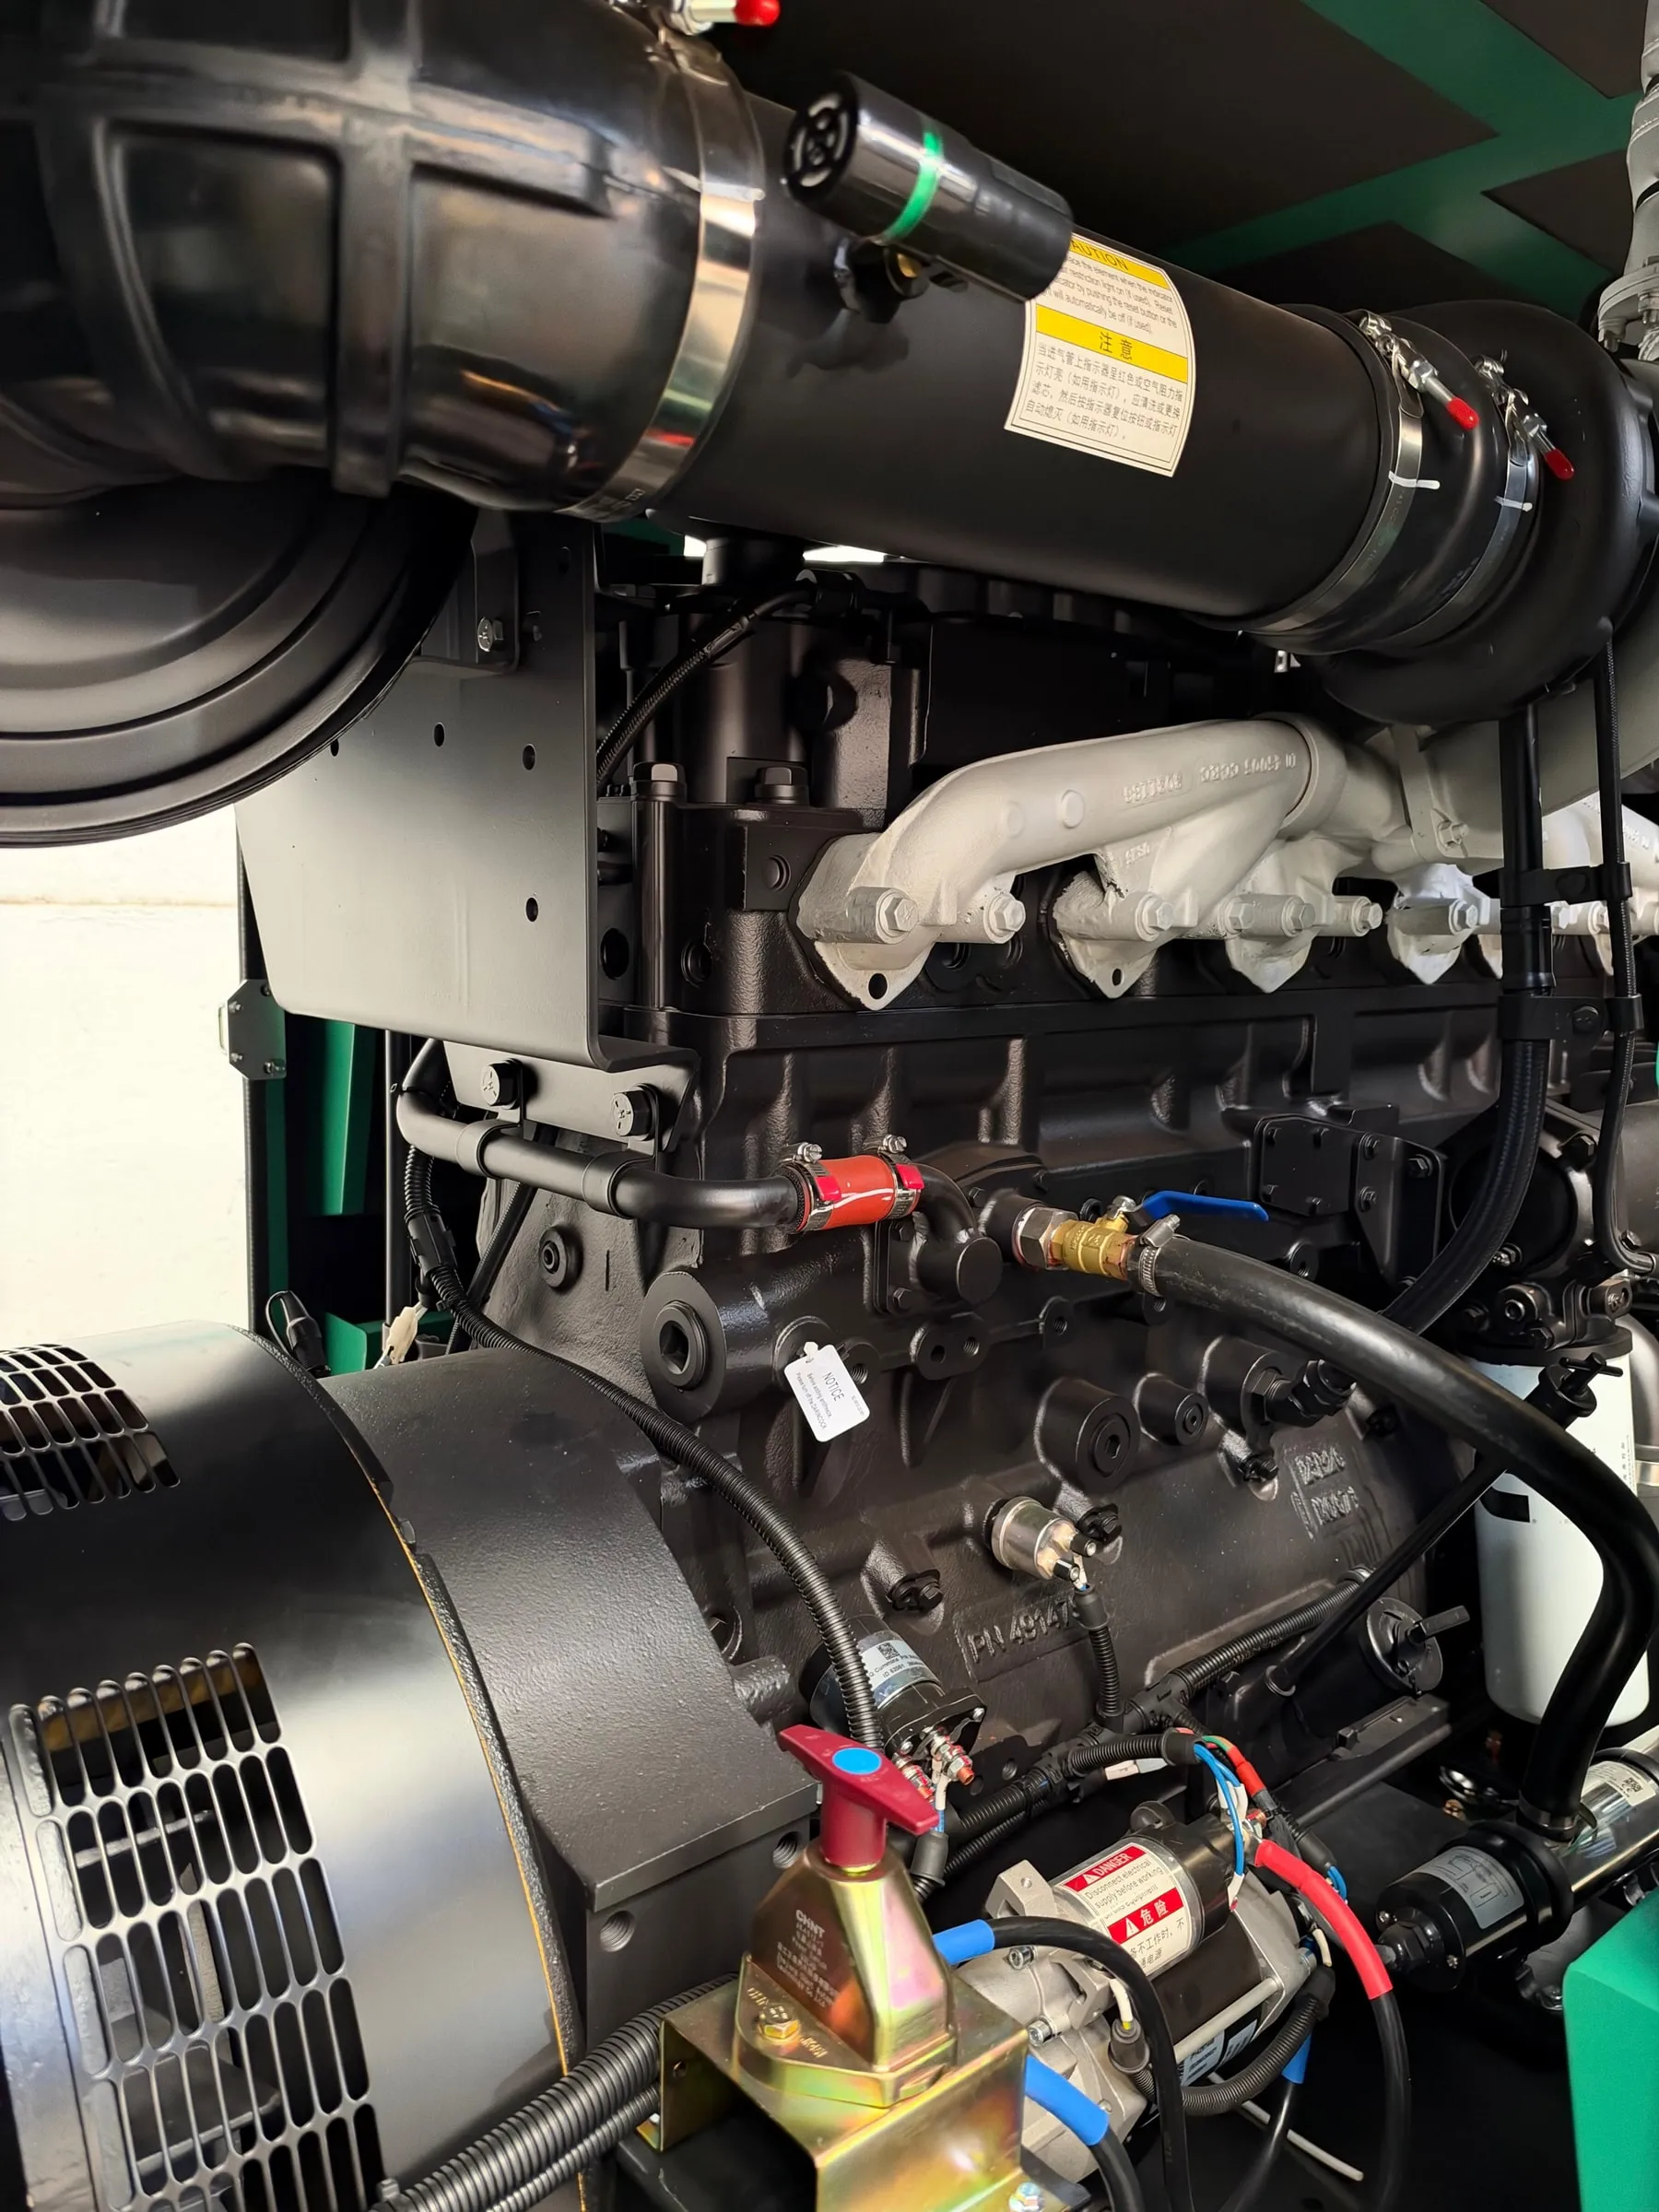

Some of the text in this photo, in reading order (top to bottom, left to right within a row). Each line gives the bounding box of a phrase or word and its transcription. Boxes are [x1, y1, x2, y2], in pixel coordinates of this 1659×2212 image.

[1070, 240, 1128, 270] AUTION
[1100, 331, 1133, 360] 注意
[823, 1371, 845, 1402] NOTICE
[1010, 1595, 1077, 1644] 49147
[1085, 1859, 1151, 1900] Disconnect electrical
[1092, 1852, 1133, 1877] DANGER
[1095, 1865, 1165, 1909] supply before working
[1140, 1900, 1170, 1927] 危险
